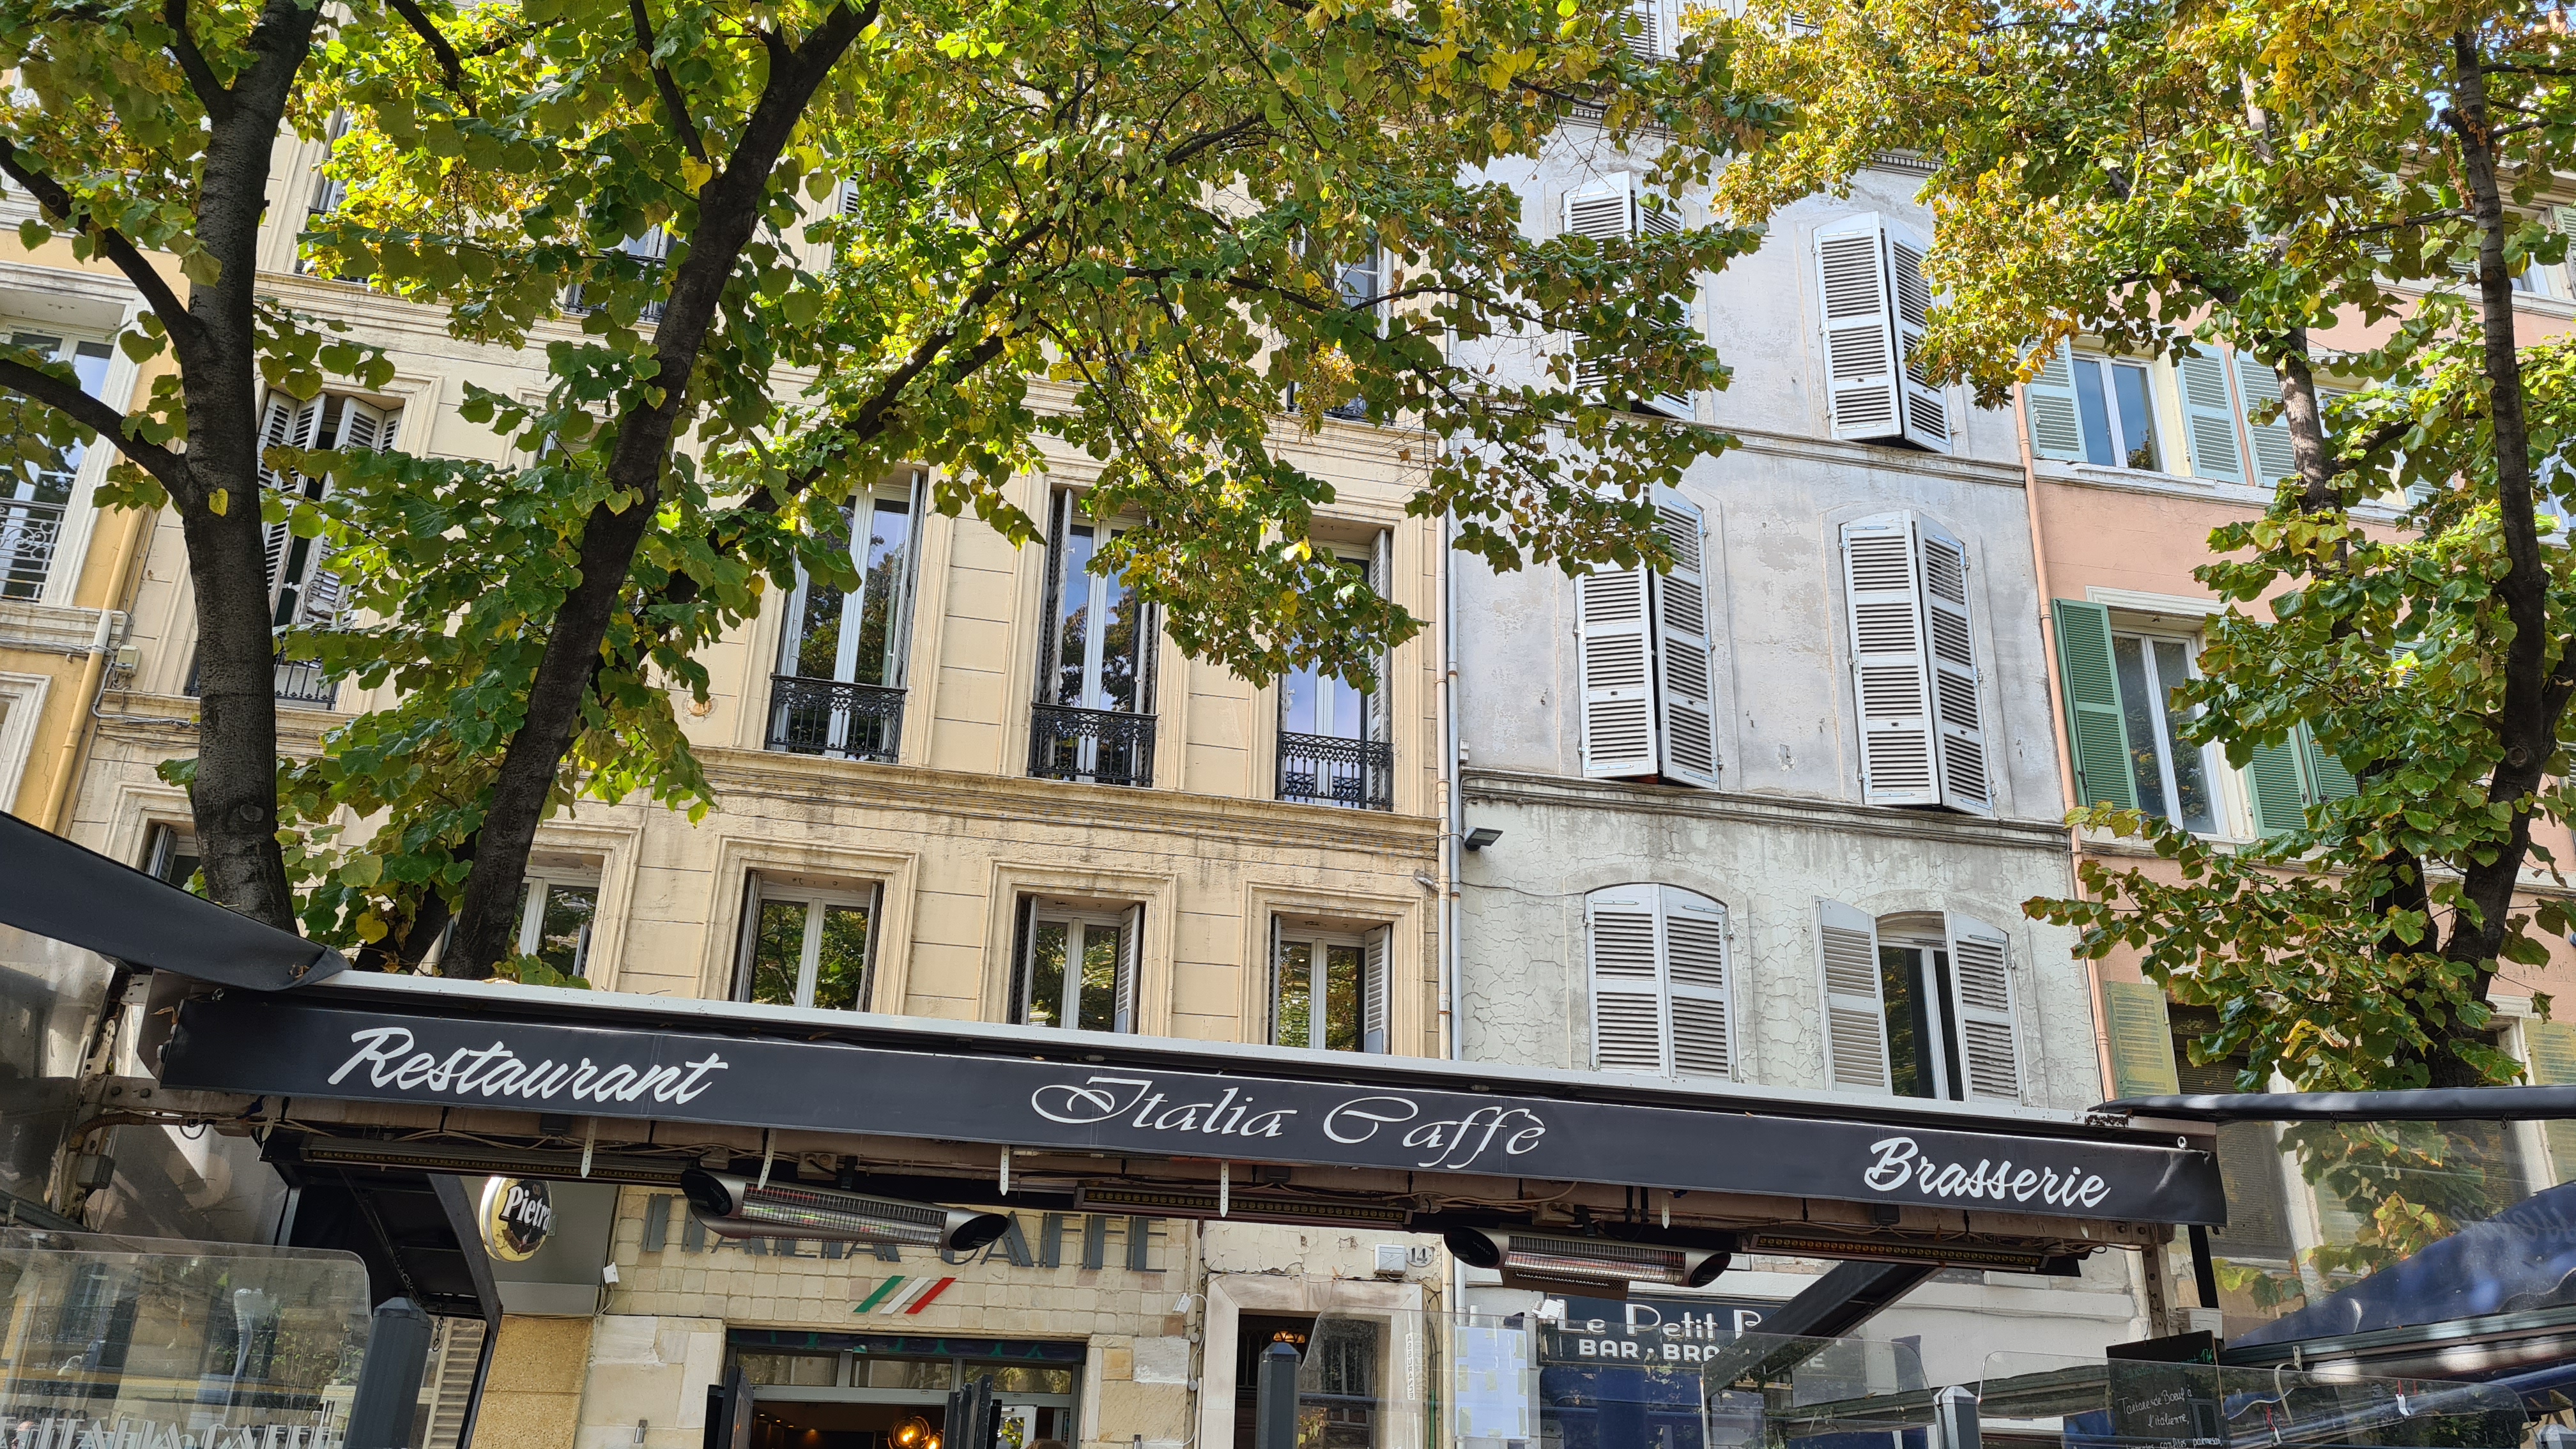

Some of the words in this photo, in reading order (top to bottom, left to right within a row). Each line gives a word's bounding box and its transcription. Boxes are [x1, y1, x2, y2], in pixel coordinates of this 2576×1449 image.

[327, 1027, 729, 1105] Restaurant
[1031, 1076, 1298, 1138] Italia
[1322, 1096, 1546, 1169] Caffè
[1864, 1137, 2111, 1208] Brasserie
[500, 1186, 551, 1231] Pietra
[1411, 1247, 1428, 1264] 14
[1556, 1299, 1606, 1335] Le
[1625, 1303, 1717, 1340] Petit
[1733, 1309, 1763, 1340] P
[1579, 1338, 1640, 1360] BAR
